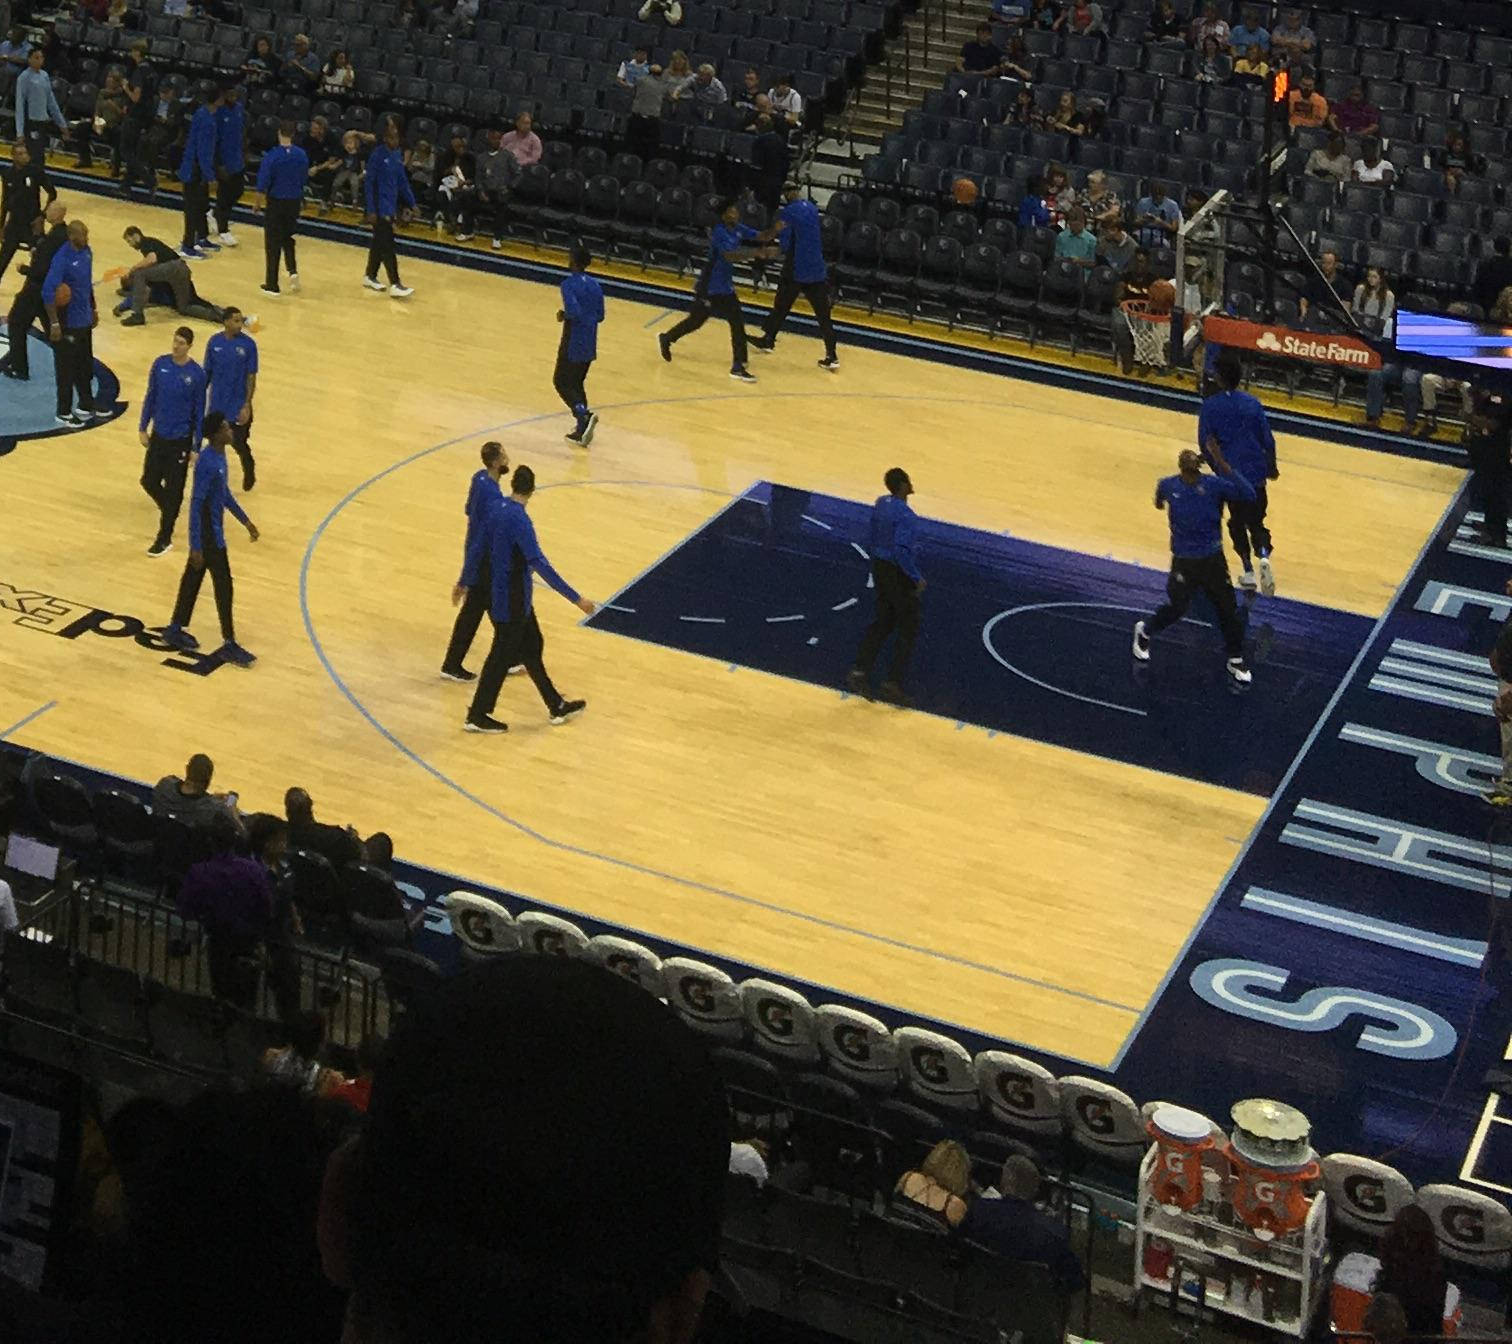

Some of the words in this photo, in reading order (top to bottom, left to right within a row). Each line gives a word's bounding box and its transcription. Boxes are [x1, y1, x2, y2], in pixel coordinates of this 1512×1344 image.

[757, 998, 793, 1036] G
[833, 1023, 870, 1061] G
[911, 1045, 949, 1084] G
[996, 1071, 1035, 1110] G
[1076, 1095, 1115, 1134] G
[1254, 1180, 1276, 1204] G
[1343, 1174, 1387, 1214] G
[1441, 1204, 1486, 1244] G
